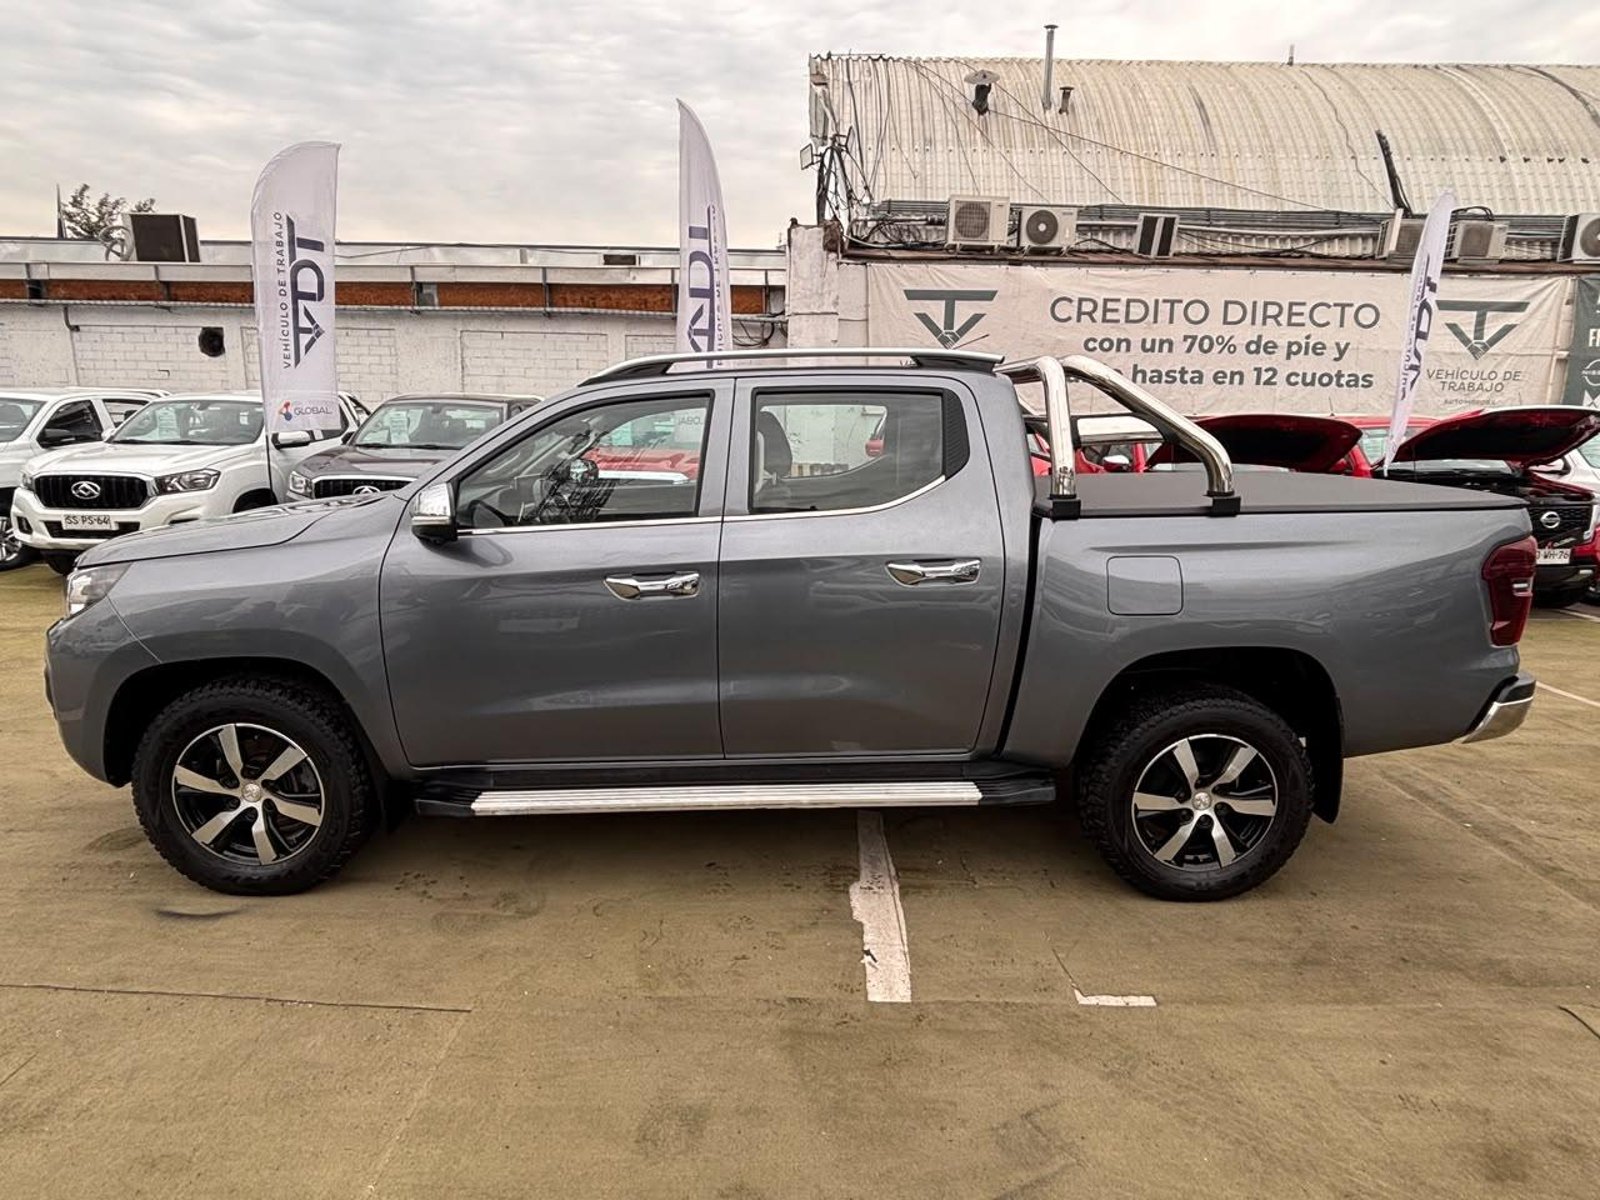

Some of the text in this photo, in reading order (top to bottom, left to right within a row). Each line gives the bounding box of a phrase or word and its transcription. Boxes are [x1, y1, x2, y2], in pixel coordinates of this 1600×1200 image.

[273, 212, 291, 369] VEHÍCULO DE TRABAJO
[1050, 296, 1380, 329] CREDITO DIRECTO
[1083, 337, 1131, 352] con
[1141, 338, 1174, 353] un
[1183, 334, 1237, 355] 70%
[1245, 334, 1278, 355] de
[1333, 341, 1351, 362] y
[1131, 364, 1374, 388] hasta en 12 cuotas
[1426, 367, 1522, 381] VEHÍCULO DE
[1440, 381, 1504, 393] TRABAJO
[294, 406, 333, 415] GLOBAL
